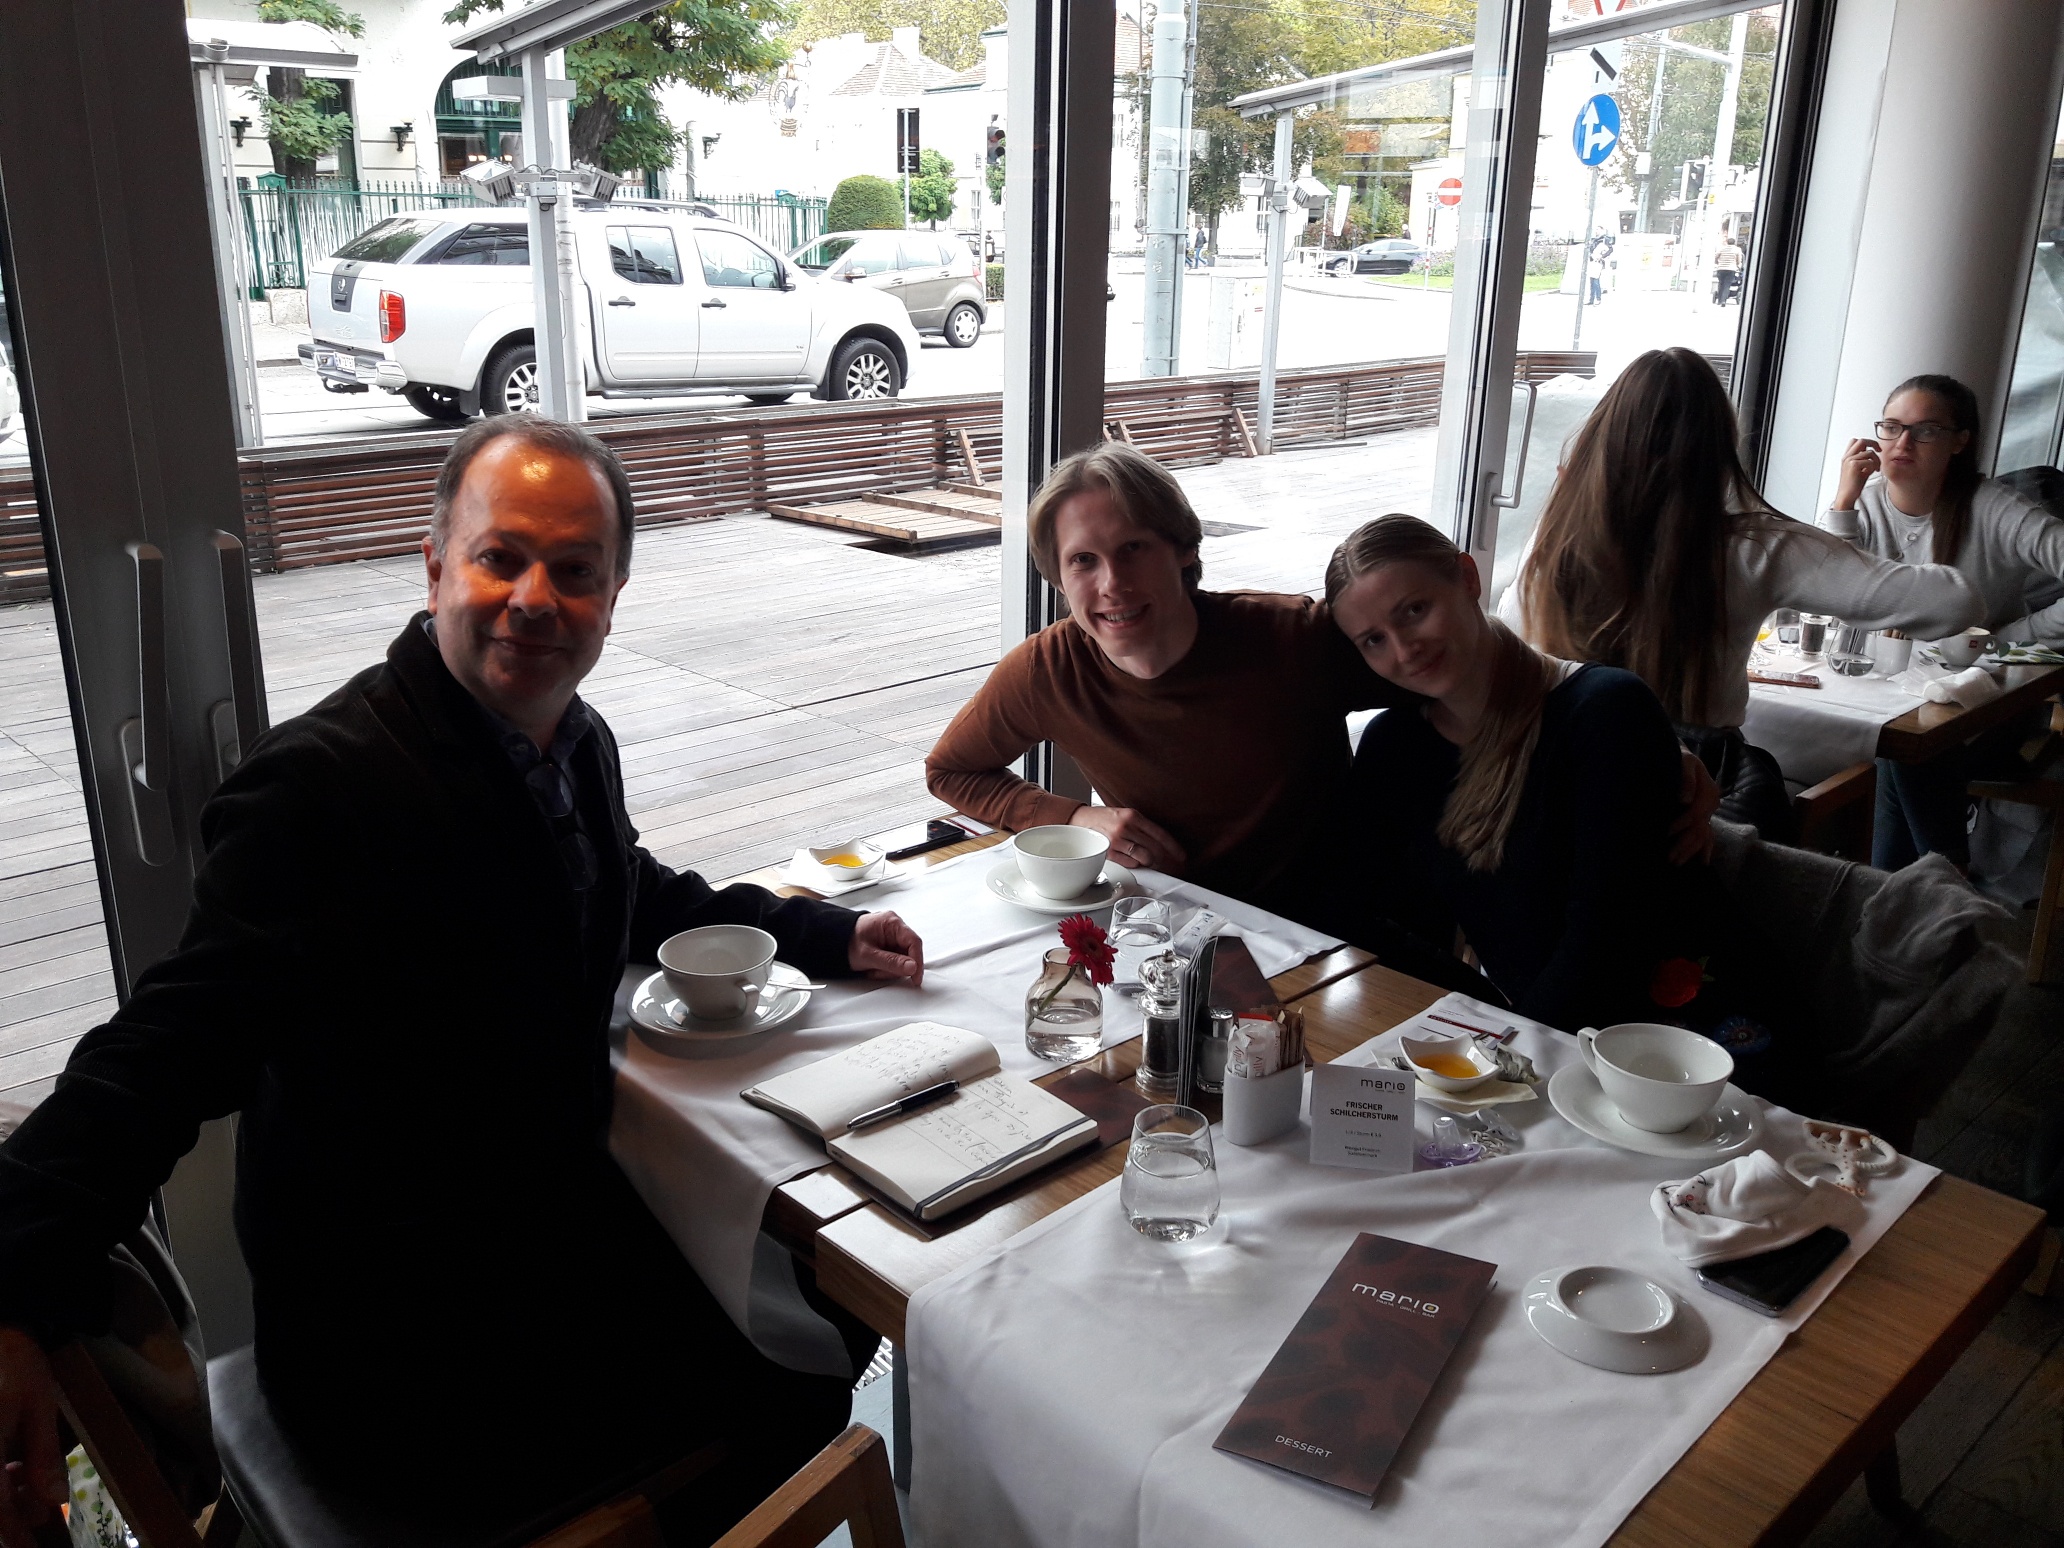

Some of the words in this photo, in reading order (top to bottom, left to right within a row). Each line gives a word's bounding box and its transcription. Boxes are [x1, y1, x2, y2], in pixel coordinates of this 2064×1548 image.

[1360, 1079, 1406, 1091] mario
[1345, 1100, 1383, 1111] FRISCHER
[1330, 1108, 1398, 1121] SCHILCHERSTURM
[1352, 1283, 1440, 1314] mario
[1274, 1434, 1333, 1458] DESSERT
